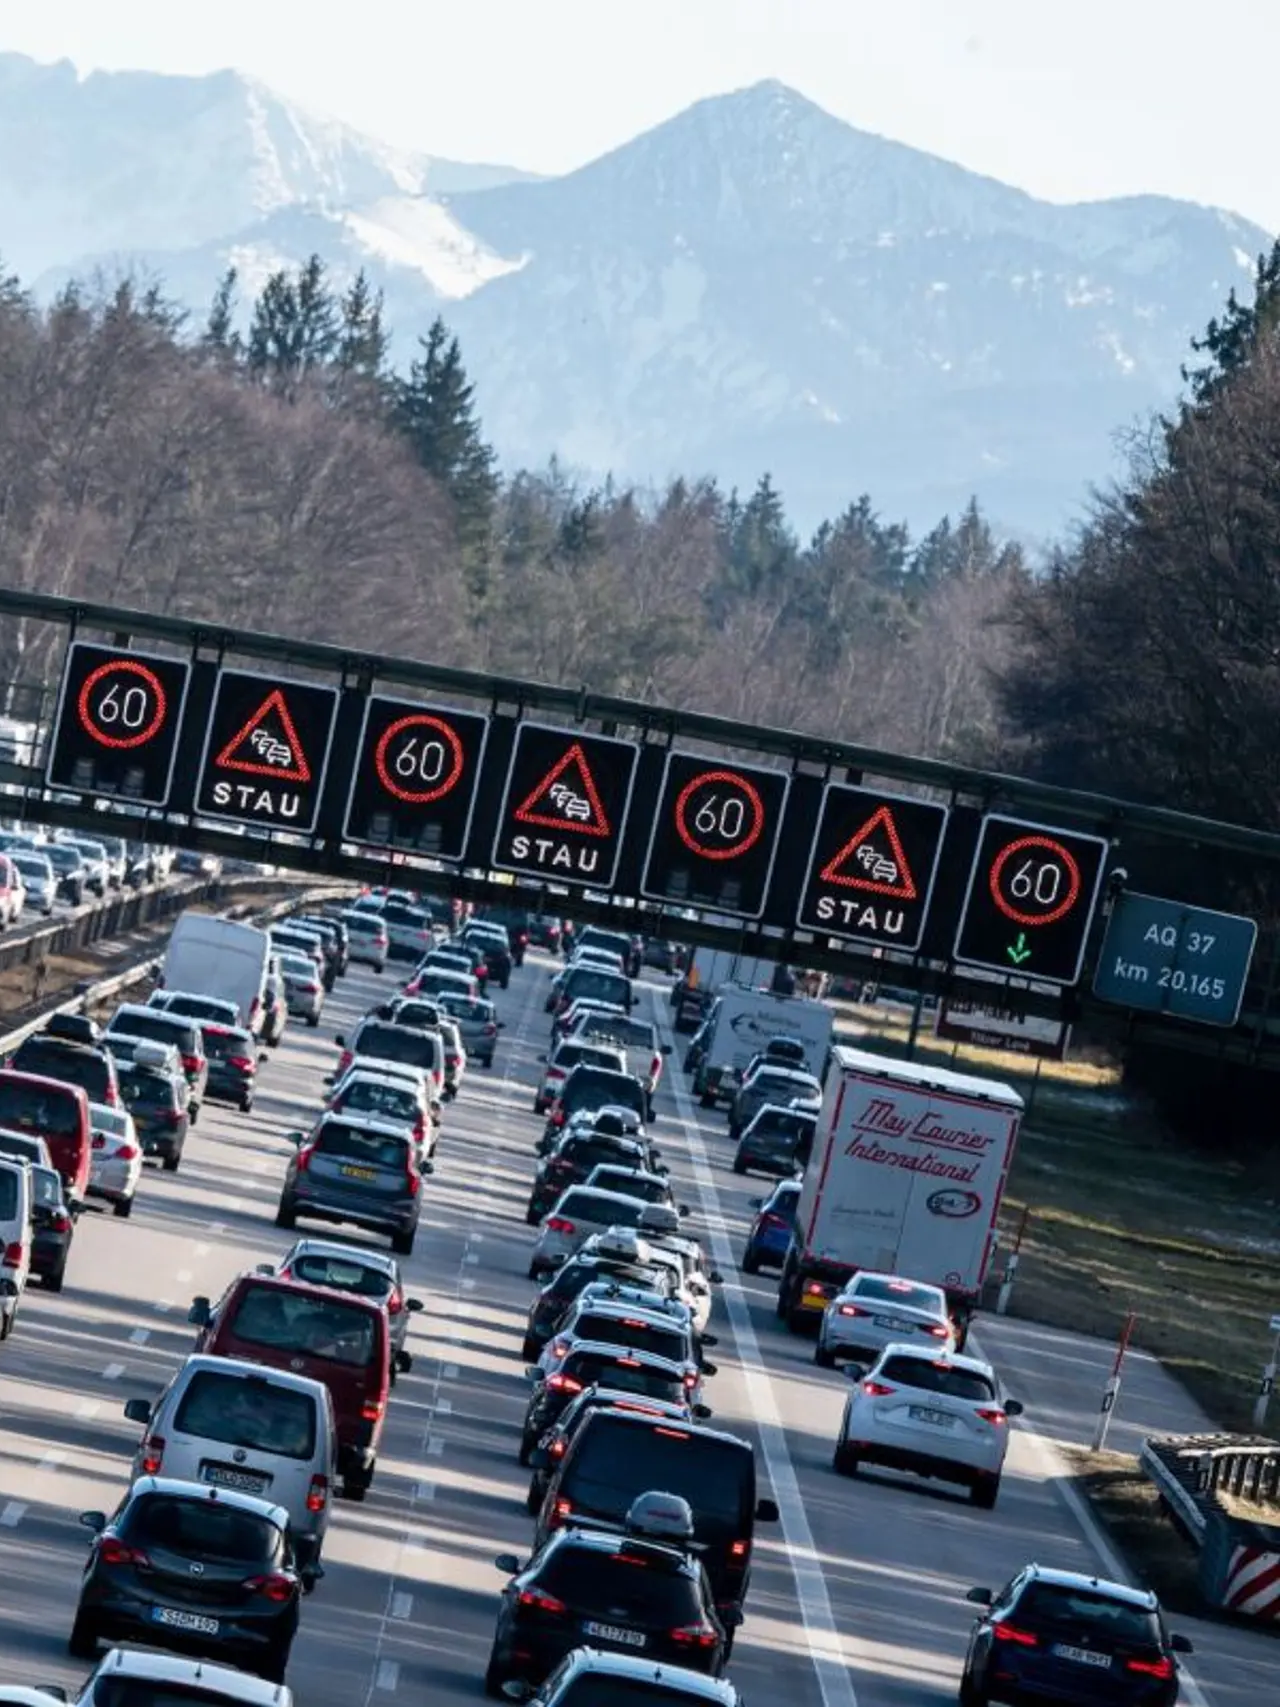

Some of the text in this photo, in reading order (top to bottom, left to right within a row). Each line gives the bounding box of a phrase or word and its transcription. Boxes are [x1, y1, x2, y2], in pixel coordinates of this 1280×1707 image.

[97, 684, 147, 728] 60
[395, 737, 445, 782] 60
[212, 781, 301, 818] STAU
[694, 794, 745, 839] 60
[510, 835, 600, 873] STAU
[1009, 859, 1061, 905] 60
[816, 896, 905, 935] STAU
[1143, 923, 1216, 954] AQ 37
[1114, 956, 1226, 999] km 20.165
[858, 1099, 996, 1149] May Courier
[844, 1133, 981, 1183] International
